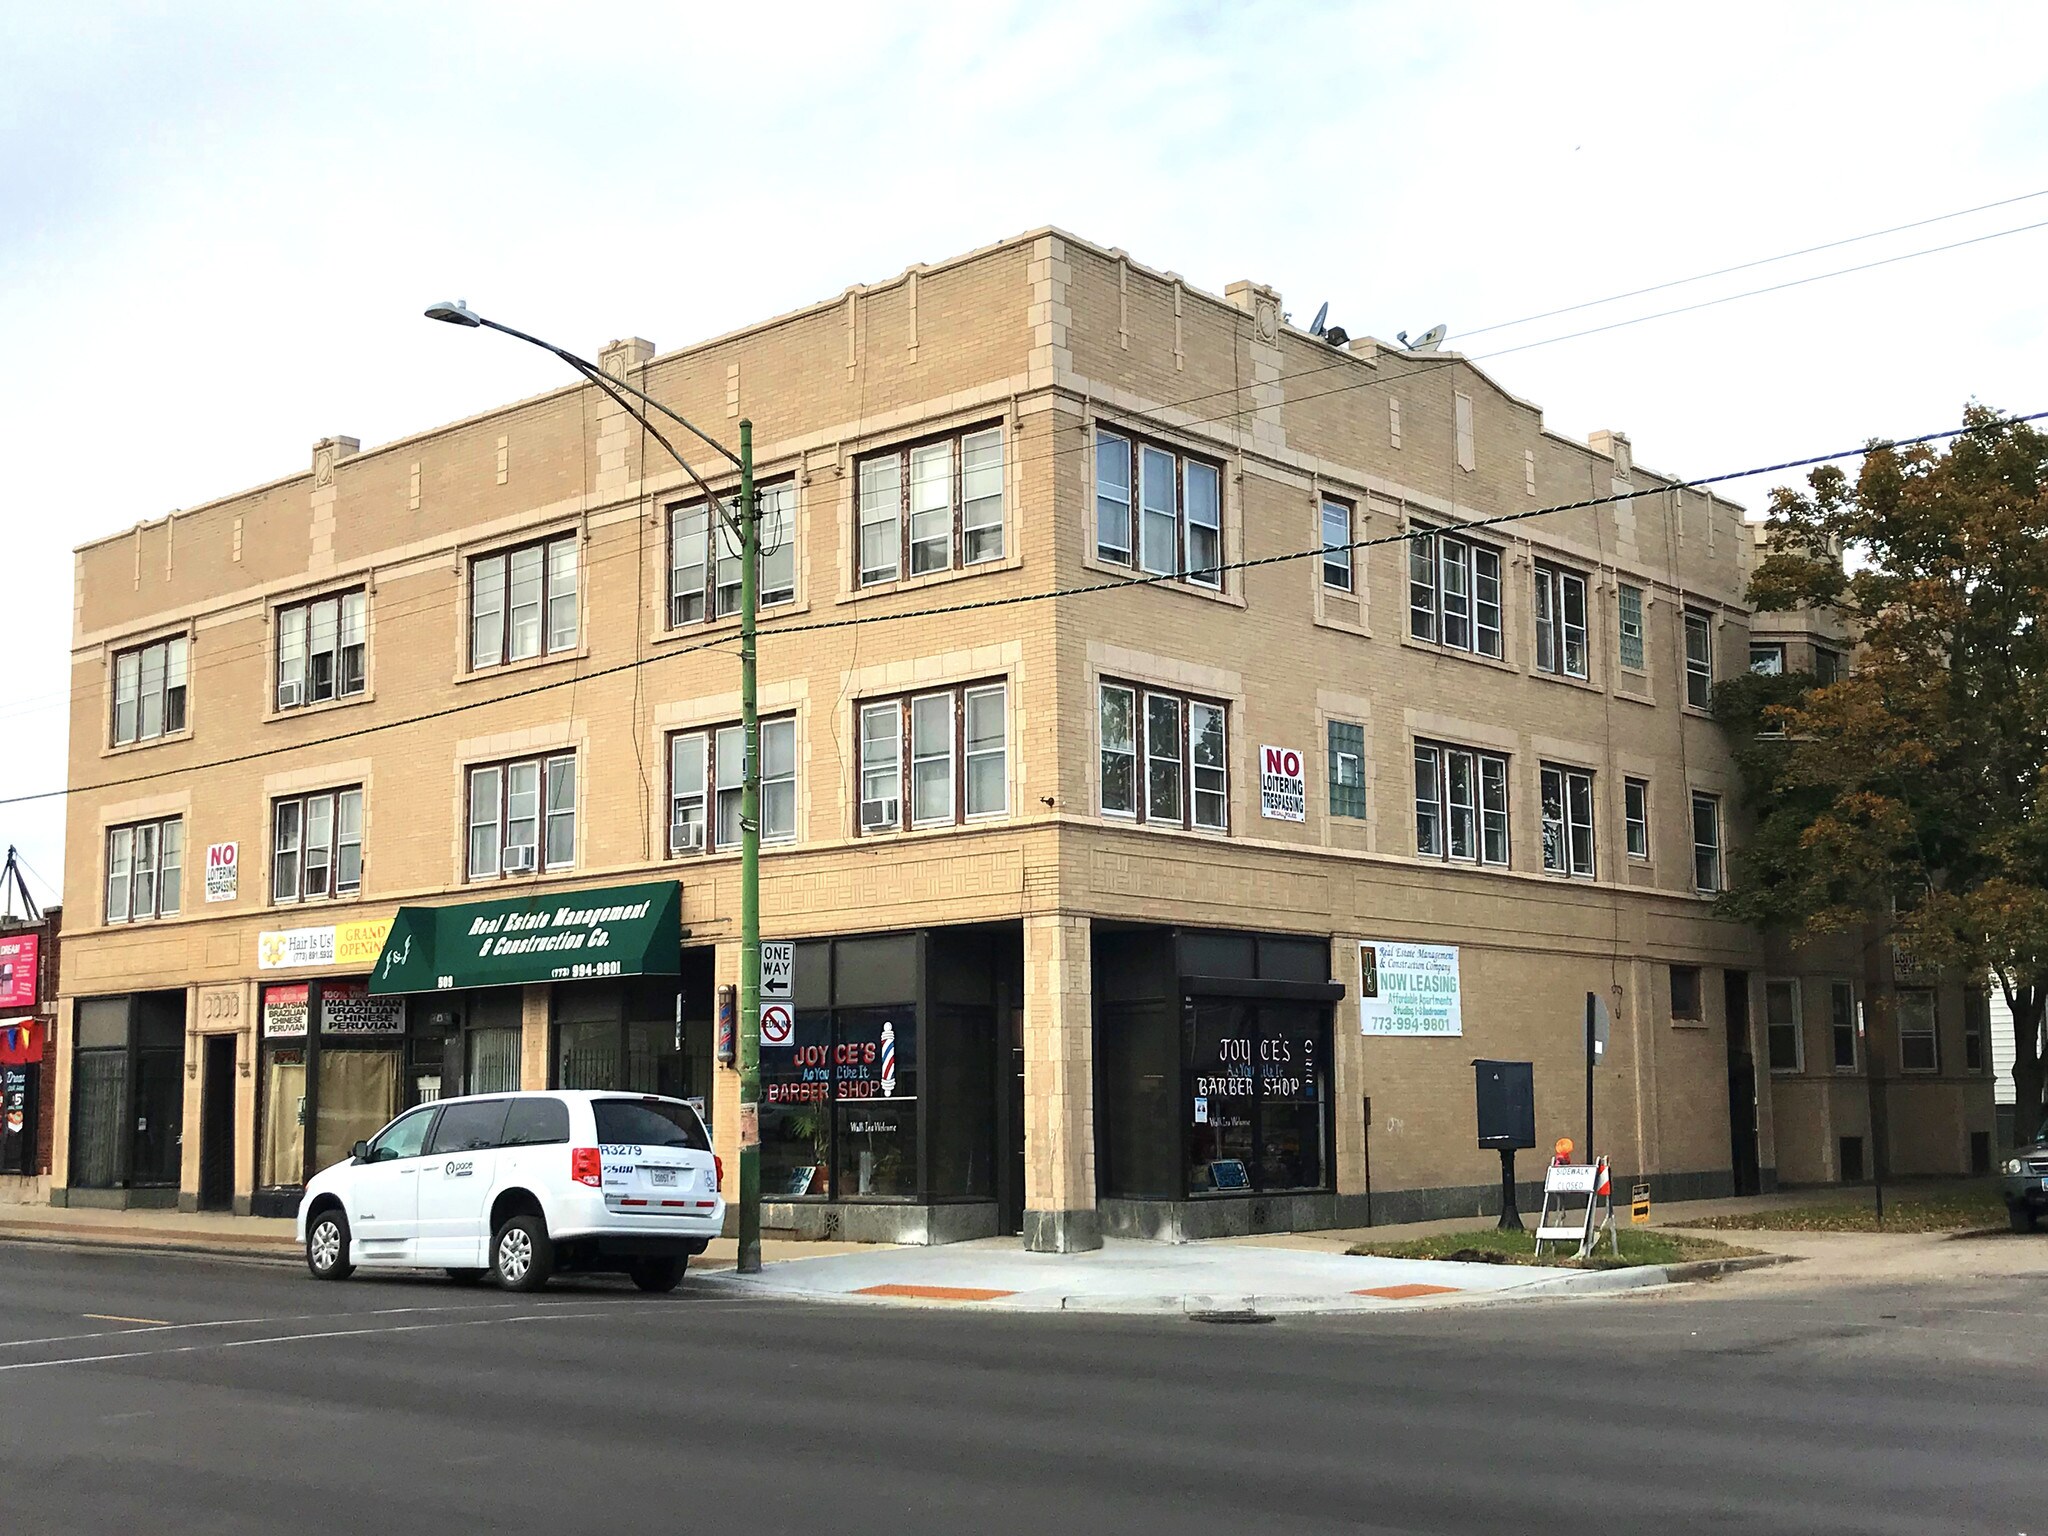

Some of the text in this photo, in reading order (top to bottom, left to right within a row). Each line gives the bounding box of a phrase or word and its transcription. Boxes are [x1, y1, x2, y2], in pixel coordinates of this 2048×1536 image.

[1266, 749, 1300, 777] NO
[1262, 774, 1303, 796] LOITERING
[1263, 791, 1304, 814] TRESPASSING
[211, 845, 235, 867] NO
[468, 899, 651, 936] Real Estate Management
[346, 925, 386, 942] GRAND
[288, 932, 334, 951] Hair Is Us!
[478, 928, 610, 957] & Construction Co.
[293, 951, 308, 962] (773)
[764, 946, 790, 960] ONE
[1379, 947, 1454, 963] Real Estate Management
[572, 961, 621, 978] 994-9801
[763, 962, 790, 976] WAY
[1379, 958, 1451, 975] & Construction Company
[1380, 973, 1457, 993] NOW LEASING
[267, 1001, 307, 1011] MALAYSIAN
[325, 999, 402, 1007] MALAYSIAN
[1387, 993, 1453, 1006] Affordable Apartments
[269, 1008, 306, 1018] BRAZILIAN
[328, 1006, 399, 1014] BRAZILIAN
[271, 1016, 303, 1025] CHINESE
[333, 1014, 393, 1022] CHINESE
[1371, 1016, 1450, 1032] 773-994-9801
[269, 1024, 304, 1033] PERUVIAN
[329, 1022, 398, 1030] PERUVIAN
[859, 1065, 870, 1079] It
[768, 1080, 880, 1103] BARBER SHOP
[1197, 1077, 1300, 1096] BARBER SHOP
[600, 1145, 642, 1155] R3279
[1556, 1167, 1589, 1176] SIDEWALK
[1557, 1181, 1583, 1190] CLOSED
